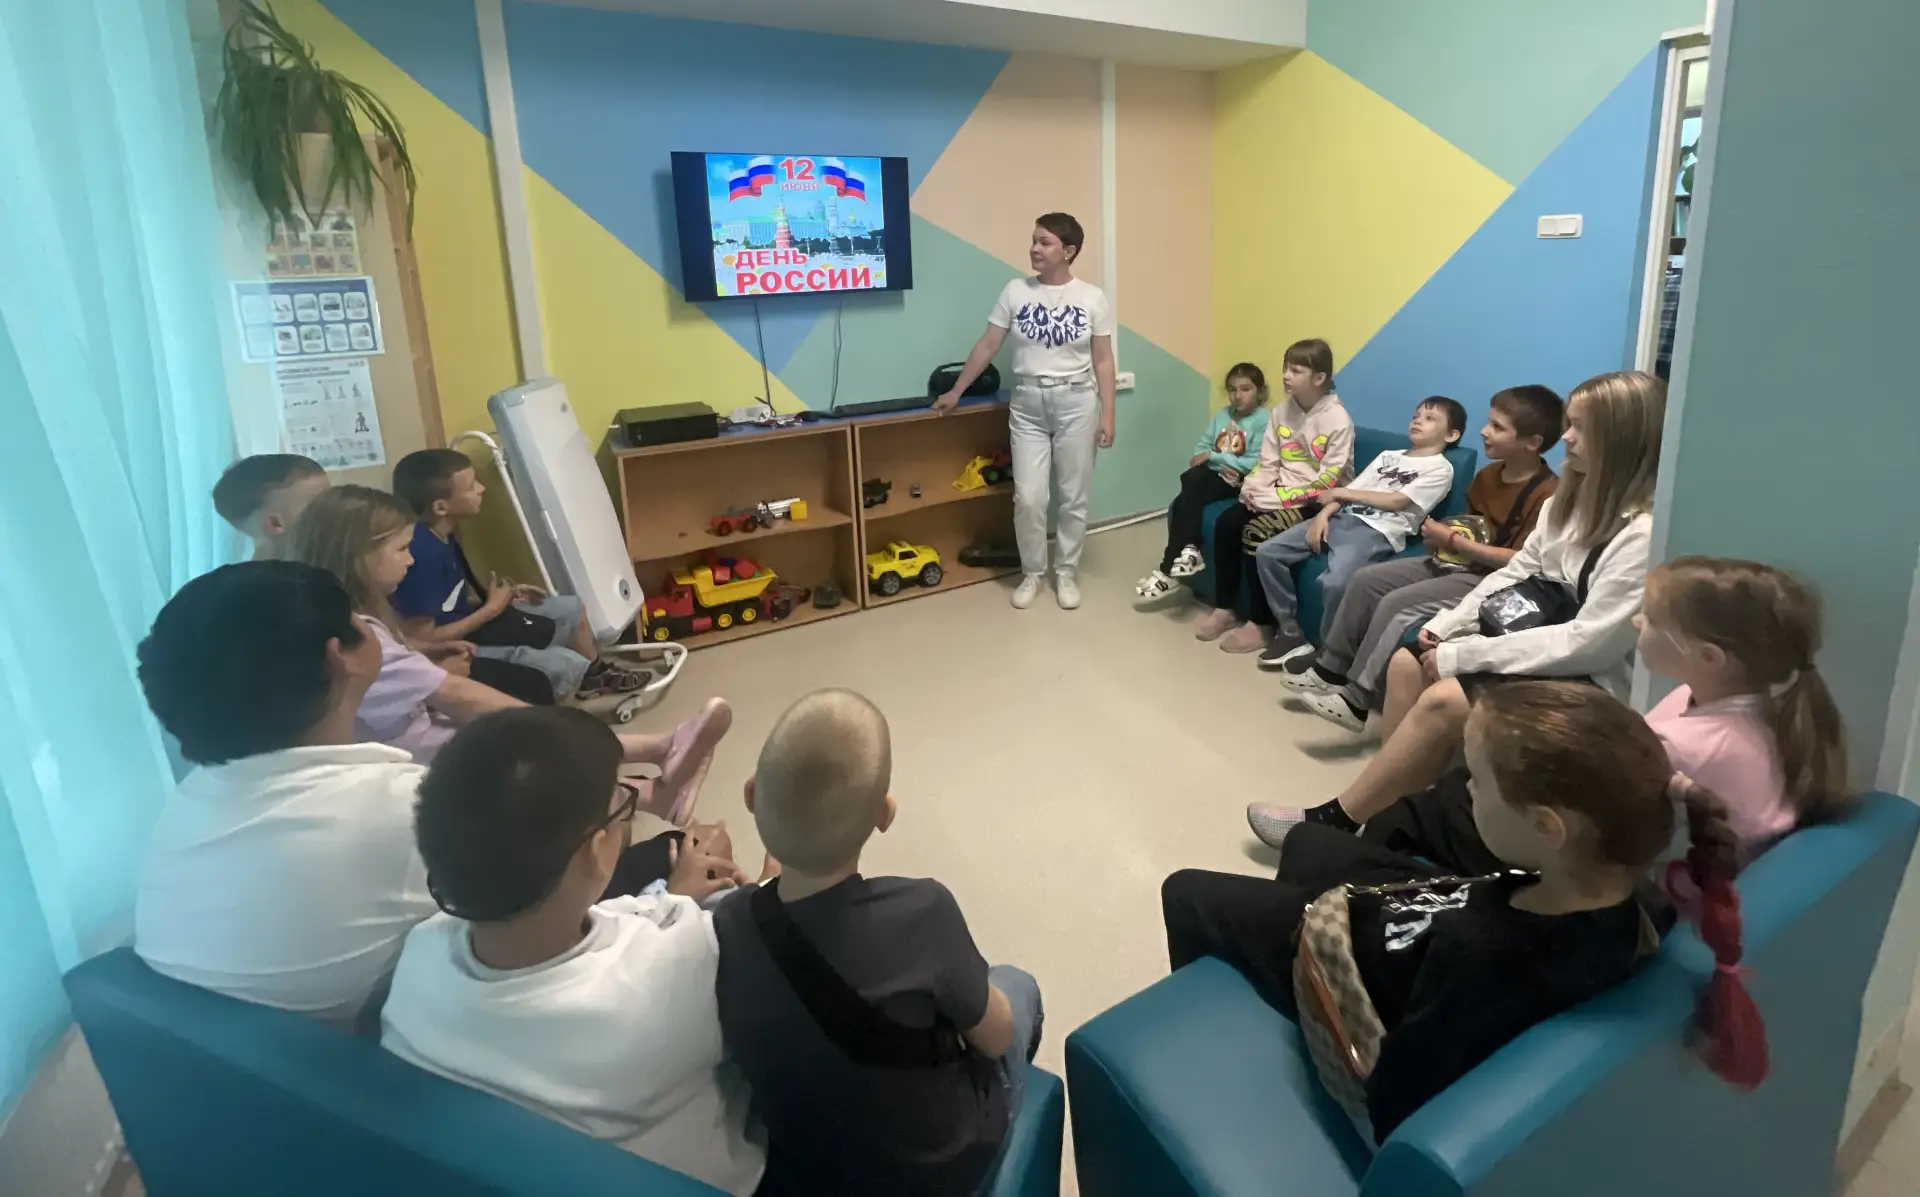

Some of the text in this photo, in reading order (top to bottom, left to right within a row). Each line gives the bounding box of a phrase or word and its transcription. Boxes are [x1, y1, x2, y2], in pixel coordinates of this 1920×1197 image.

[779, 158, 815, 180] 12
[735, 249, 808, 270] ДЕНЬ
[736, 267, 871, 294] РОССИИ
